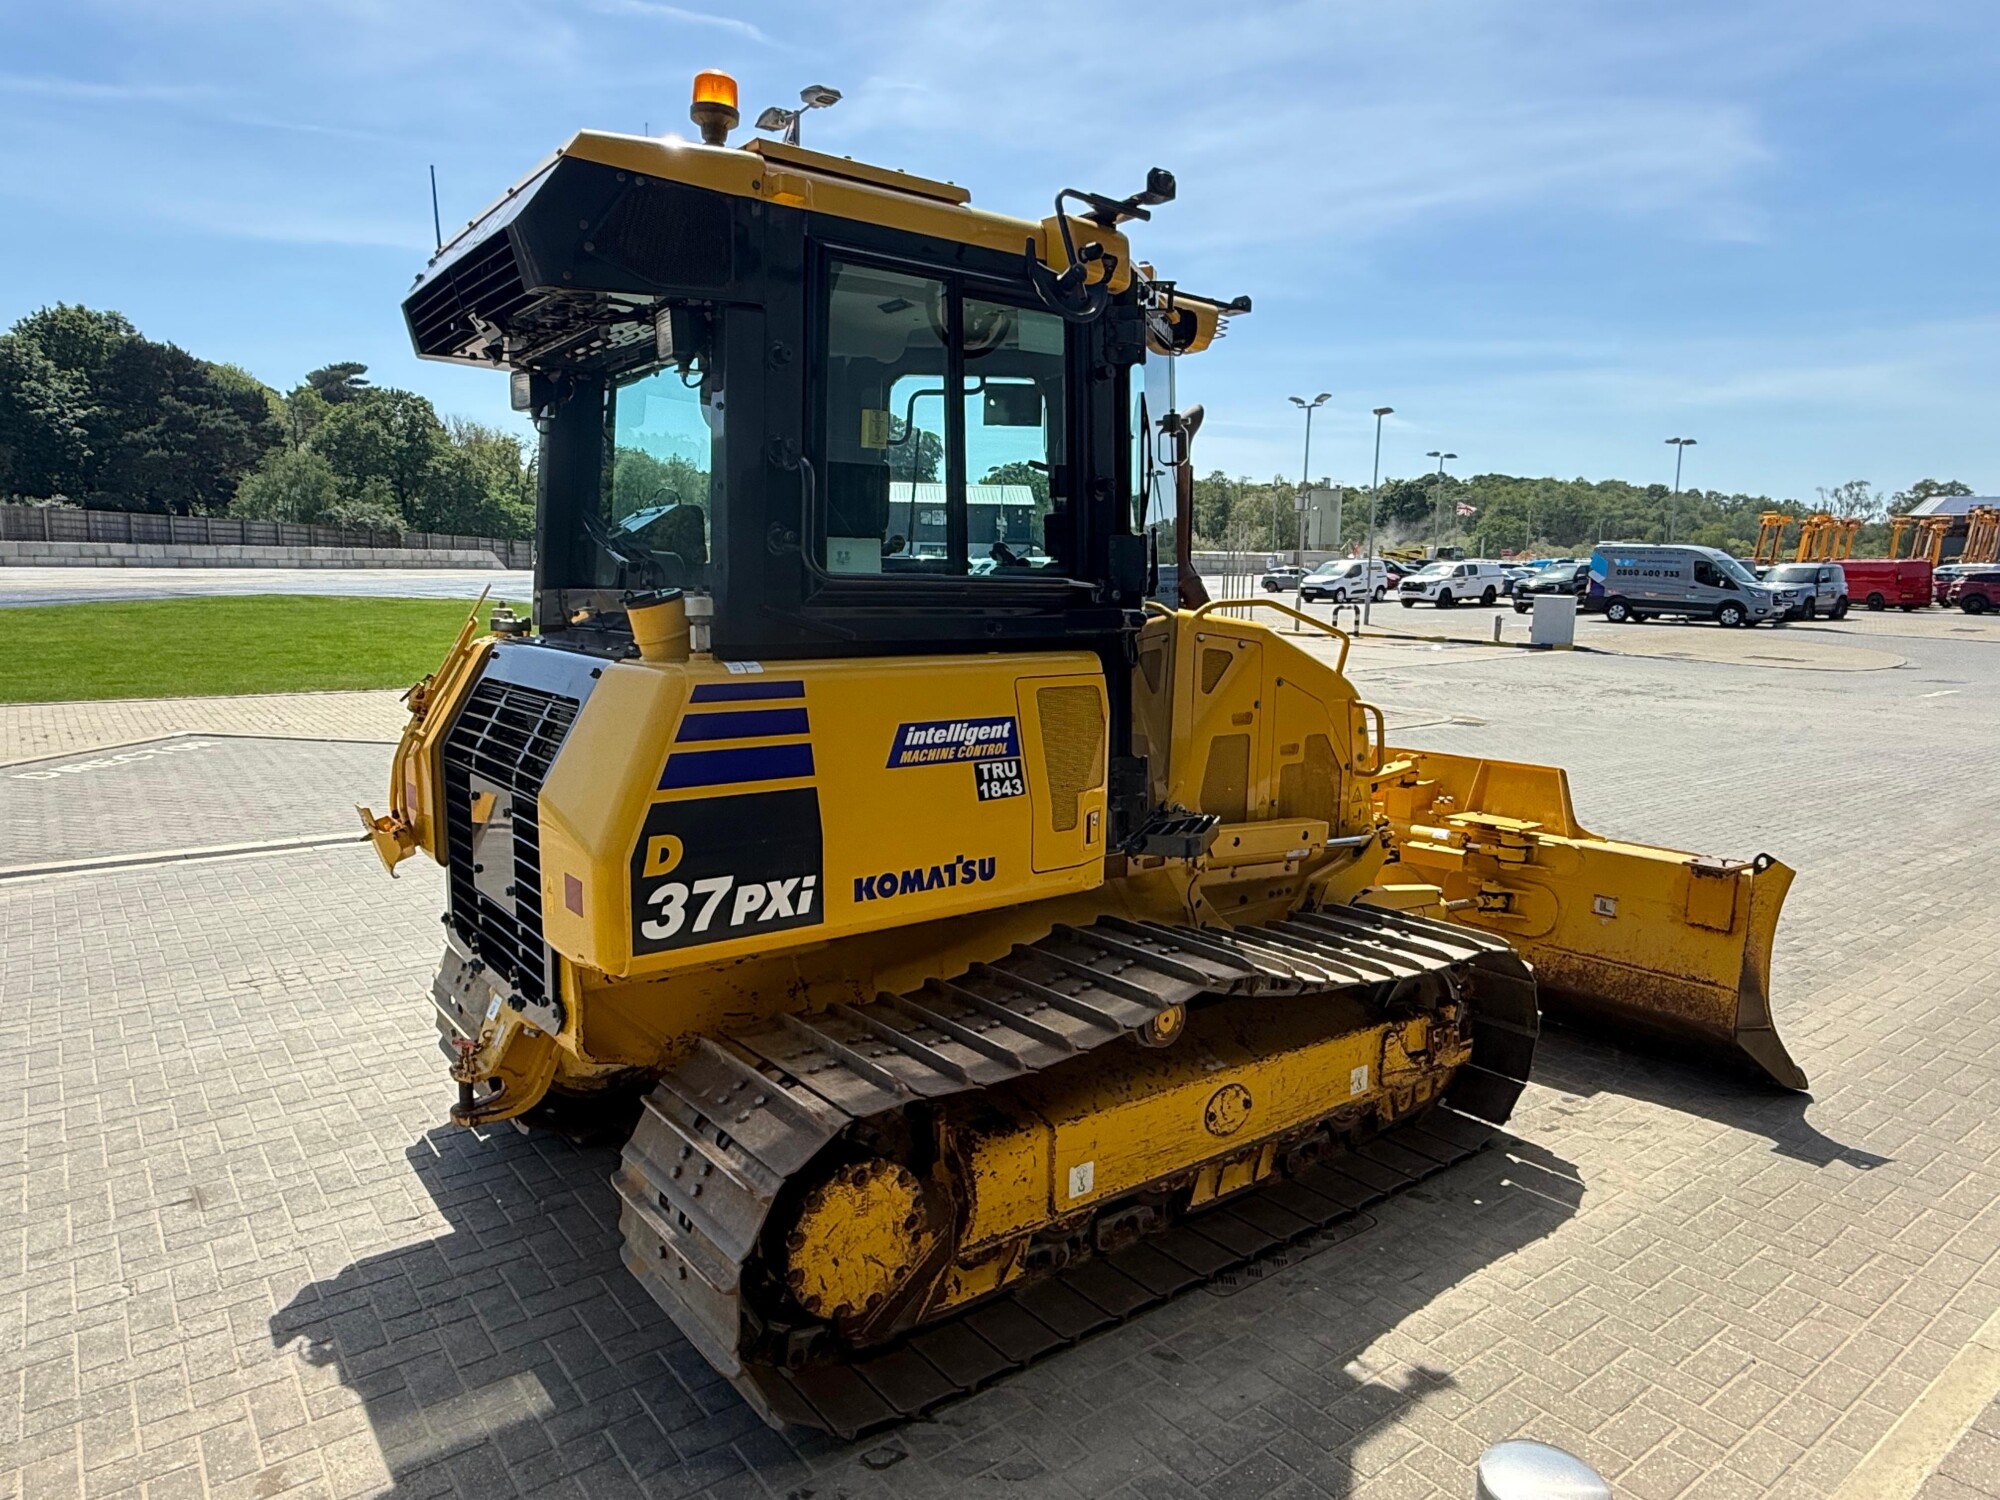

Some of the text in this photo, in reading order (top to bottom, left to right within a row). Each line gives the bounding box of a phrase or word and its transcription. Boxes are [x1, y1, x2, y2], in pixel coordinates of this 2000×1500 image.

[1642, 569, 1661, 577] 400
[904, 721, 1012, 746] intelligent
[9, 741, 223, 780] DIRECTOR
[899, 742, 1008, 764] MACHINE CONTROL
[978, 761, 1017, 780] TRU
[979, 778, 1024, 799] 1843
[642, 834, 684, 878] D
[853, 854, 996, 903] KOMATSU
